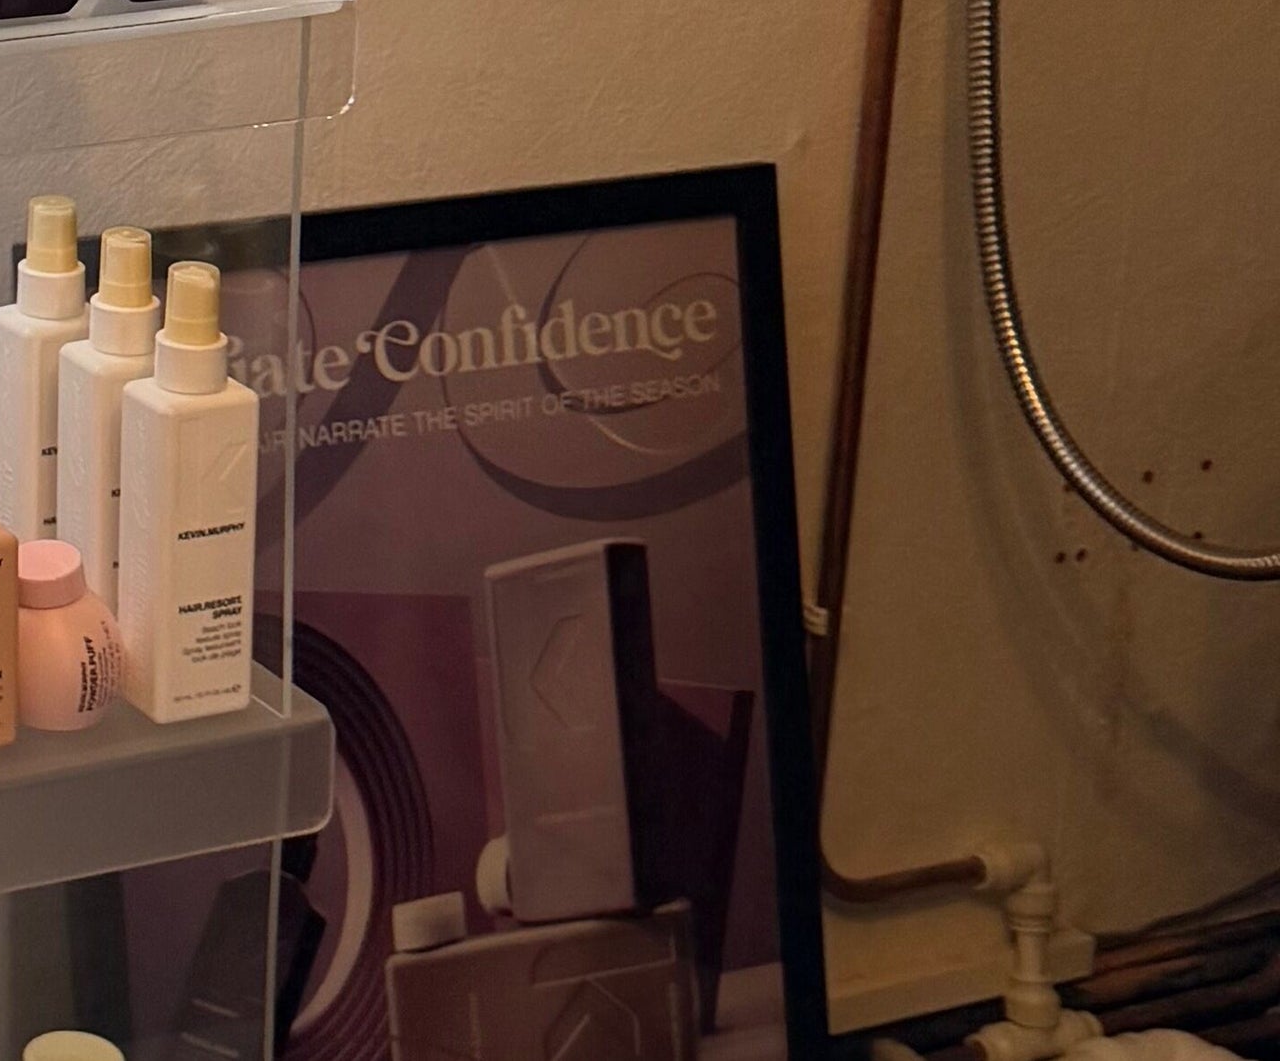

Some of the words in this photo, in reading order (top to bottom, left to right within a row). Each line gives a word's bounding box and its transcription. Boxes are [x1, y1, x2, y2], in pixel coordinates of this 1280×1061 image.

[356, 299, 718, 383] Confidence
[298, 413, 406, 449] NARRATE
[416, 406, 457, 432] THE
[464, 396, 533, 425] SPIRIT
[541, 393, 572, 417] OF
[580, 385, 624, 410] THE
[630, 373, 721, 405] SEASON
[178, 522, 245, 541] KEVIN.MURPHY
[212, 605, 242, 619] SPRAY
